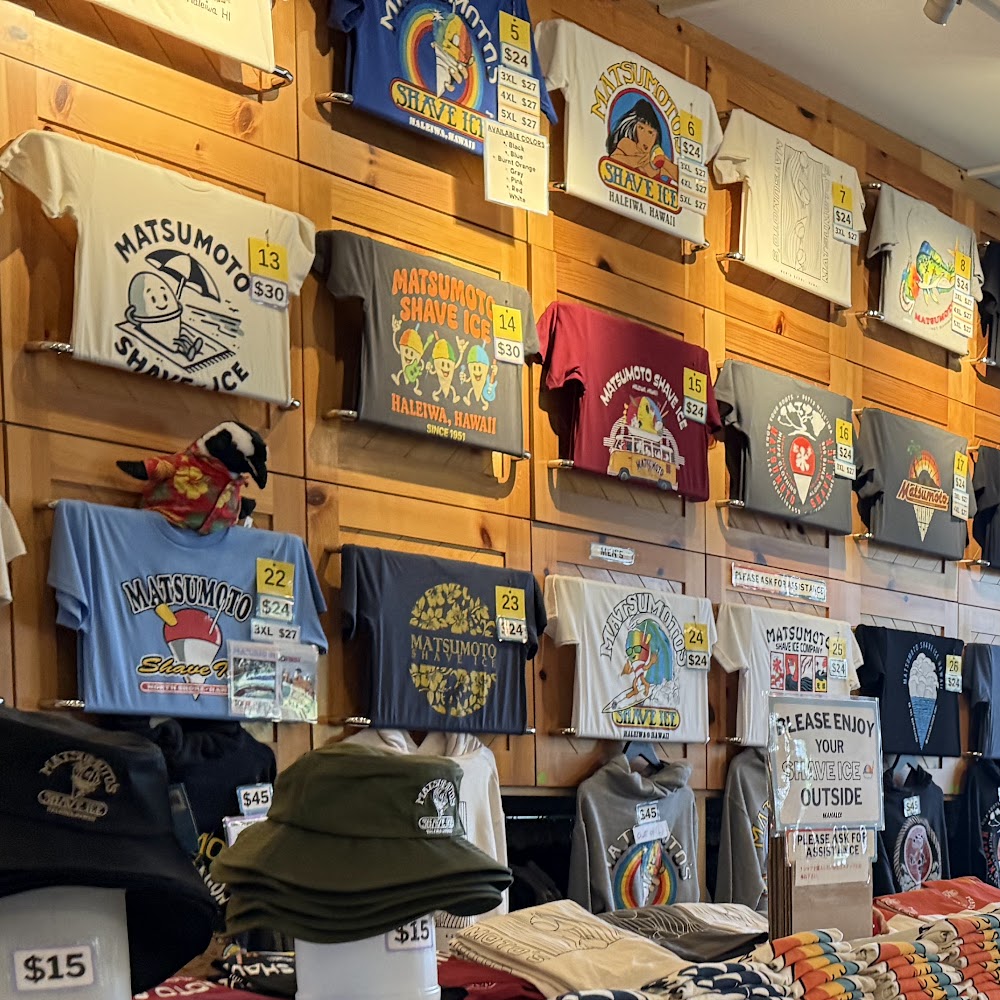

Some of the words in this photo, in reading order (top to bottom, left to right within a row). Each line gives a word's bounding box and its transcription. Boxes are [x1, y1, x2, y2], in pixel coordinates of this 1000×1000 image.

[222, 8, 230, 21] HI
[511, 26, 519, 40] 5
[504, 47, 528, 67] $24
[500, 71, 516, 85] 3XL
[522, 77, 536, 91] $27
[396, 84, 457, 127] SHAVE
[500, 91, 516, 104] 4XL
[522, 96, 536, 110] $27
[500, 109, 516, 123] 5XL
[522, 114, 536, 128] $27
[487, 124, 521, 141] AVAILABLE
[521, 134, 545, 148] COLORS
[687, 121, 694, 136] 6
[682, 142, 701, 159] $24
[680, 161, 692, 172] 3XL
[695, 166, 706, 177] $27
[604, 163, 654, 199] SHAVE
[657, 182, 679, 210] ICE
[680, 179, 692, 190] 4XL
[695, 183, 707, 194] $27
[680, 195, 692, 206] 5XL
[695, 199, 706, 210] $27
[840, 190, 846, 203] 7
[835, 210, 851, 224] $24
[835, 227, 845, 237] 3XL
[848, 231, 858, 241] $27
[114, 219, 250, 294] MATSUMOTO
[258, 248, 281, 271] 13
[960, 260, 965, 271] 8
[253, 280, 285, 302] $30
[956, 278, 969, 290] $24
[392, 268, 496, 320] MATSUMOTO
[400, 297, 458, 329] SHAVE
[464, 309, 491, 343] ICE
[499, 315, 516, 332] 14
[497, 343, 520, 358] $30
[688, 376, 702, 393] 15
[600, 365, 652, 407] MATSUMOTO
[653, 374, 678, 410] SHAVE
[675, 406, 688, 431] ICE
[391, 393, 451, 426] HALEIWA,
[454, 410, 497, 434] HAWAII
[686, 402, 704, 418] $24
[426, 423, 448, 437] SINCE
[450, 429, 466, 441] 1951
[840, 426, 848, 440] 16
[840, 447, 851, 459] $24
[957, 458, 964, 470] 17
[956, 479, 965, 489] $24
[264, 568, 286, 587] 22
[123, 574, 252, 622] MATSUMOTO
[502, 594, 519, 610] 23
[262, 600, 290, 616] $24
[254, 624, 273, 637] 3XL
[279, 629, 297, 640] $27
[689, 630, 704, 644] 24
[411, 634, 497, 659] MATSUMOTO
[776, 642, 792, 651] SHAVE
[792, 642, 800, 652] ICE
[800, 643, 822, 654] COMPANY
[832, 643, 843, 655] 25
[137, 657, 212, 677] Shave
[412, 651, 462, 664] SHAVE
[474, 657, 496, 668] ICE
[688, 655, 707, 666] $24
[949, 661, 959, 672] 26
[832, 664, 845, 673] $24
[948, 679, 960, 688] $24
[616, 709, 656, 725] SHAVE
[659, 711, 677, 727] ICE
[777, 712, 831, 736] PLEASE
[834, 713, 875, 738] ENJOY
[815, 739, 844, 754] YOUR
[782, 761, 836, 781] SHAVE
[838, 761, 861, 781] ICE
[243, 790, 269, 806] $45
[801, 787, 862, 807] OUTSIDE
[797, 833, 830, 846] PLEASE
[832, 834, 850, 845] ASK
[394, 920, 430, 944] $15
[24, 953, 86, 983] $15
